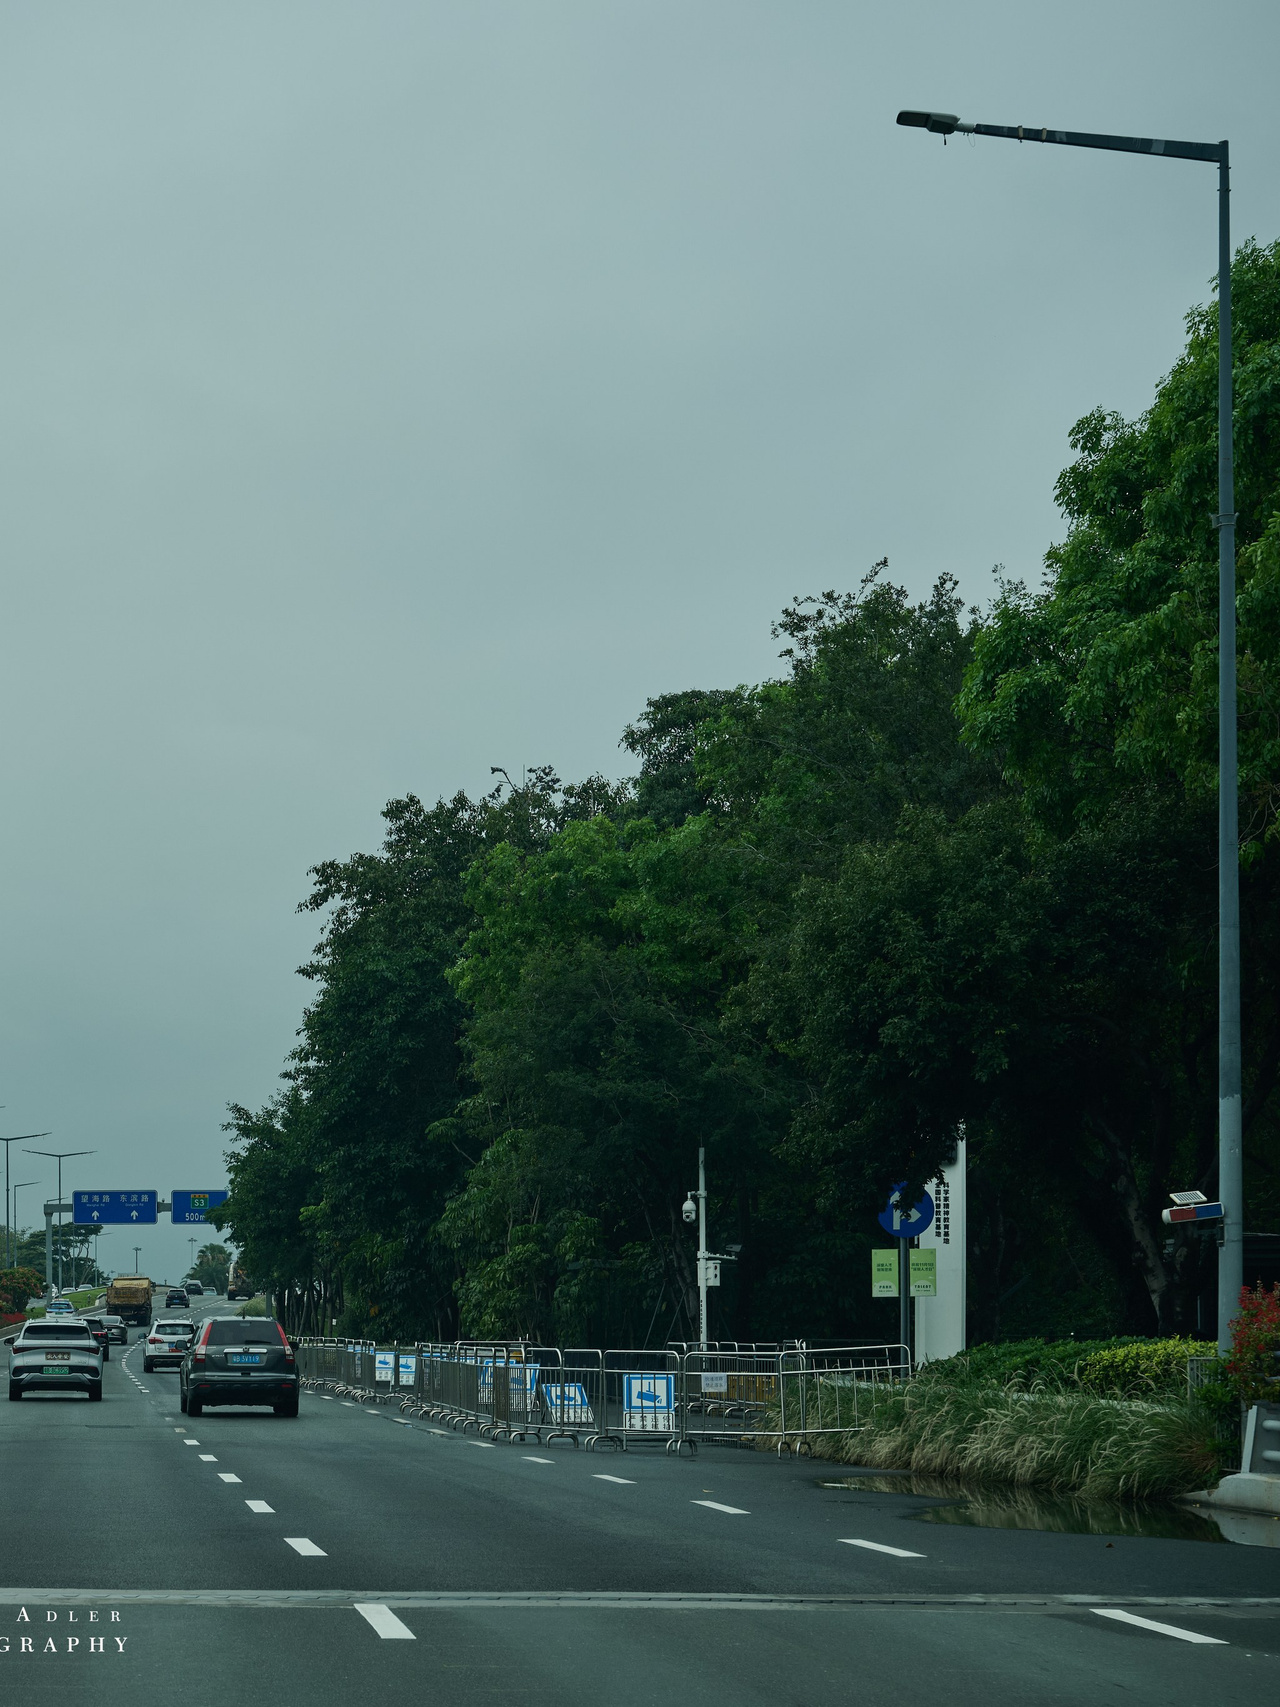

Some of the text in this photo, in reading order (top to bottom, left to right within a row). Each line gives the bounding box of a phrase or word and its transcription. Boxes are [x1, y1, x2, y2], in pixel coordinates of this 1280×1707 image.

[80, 1194, 111, 1203] 望海路
[119, 1194, 149, 1203] 东滨路
[194, 1198, 205, 1207] S3
